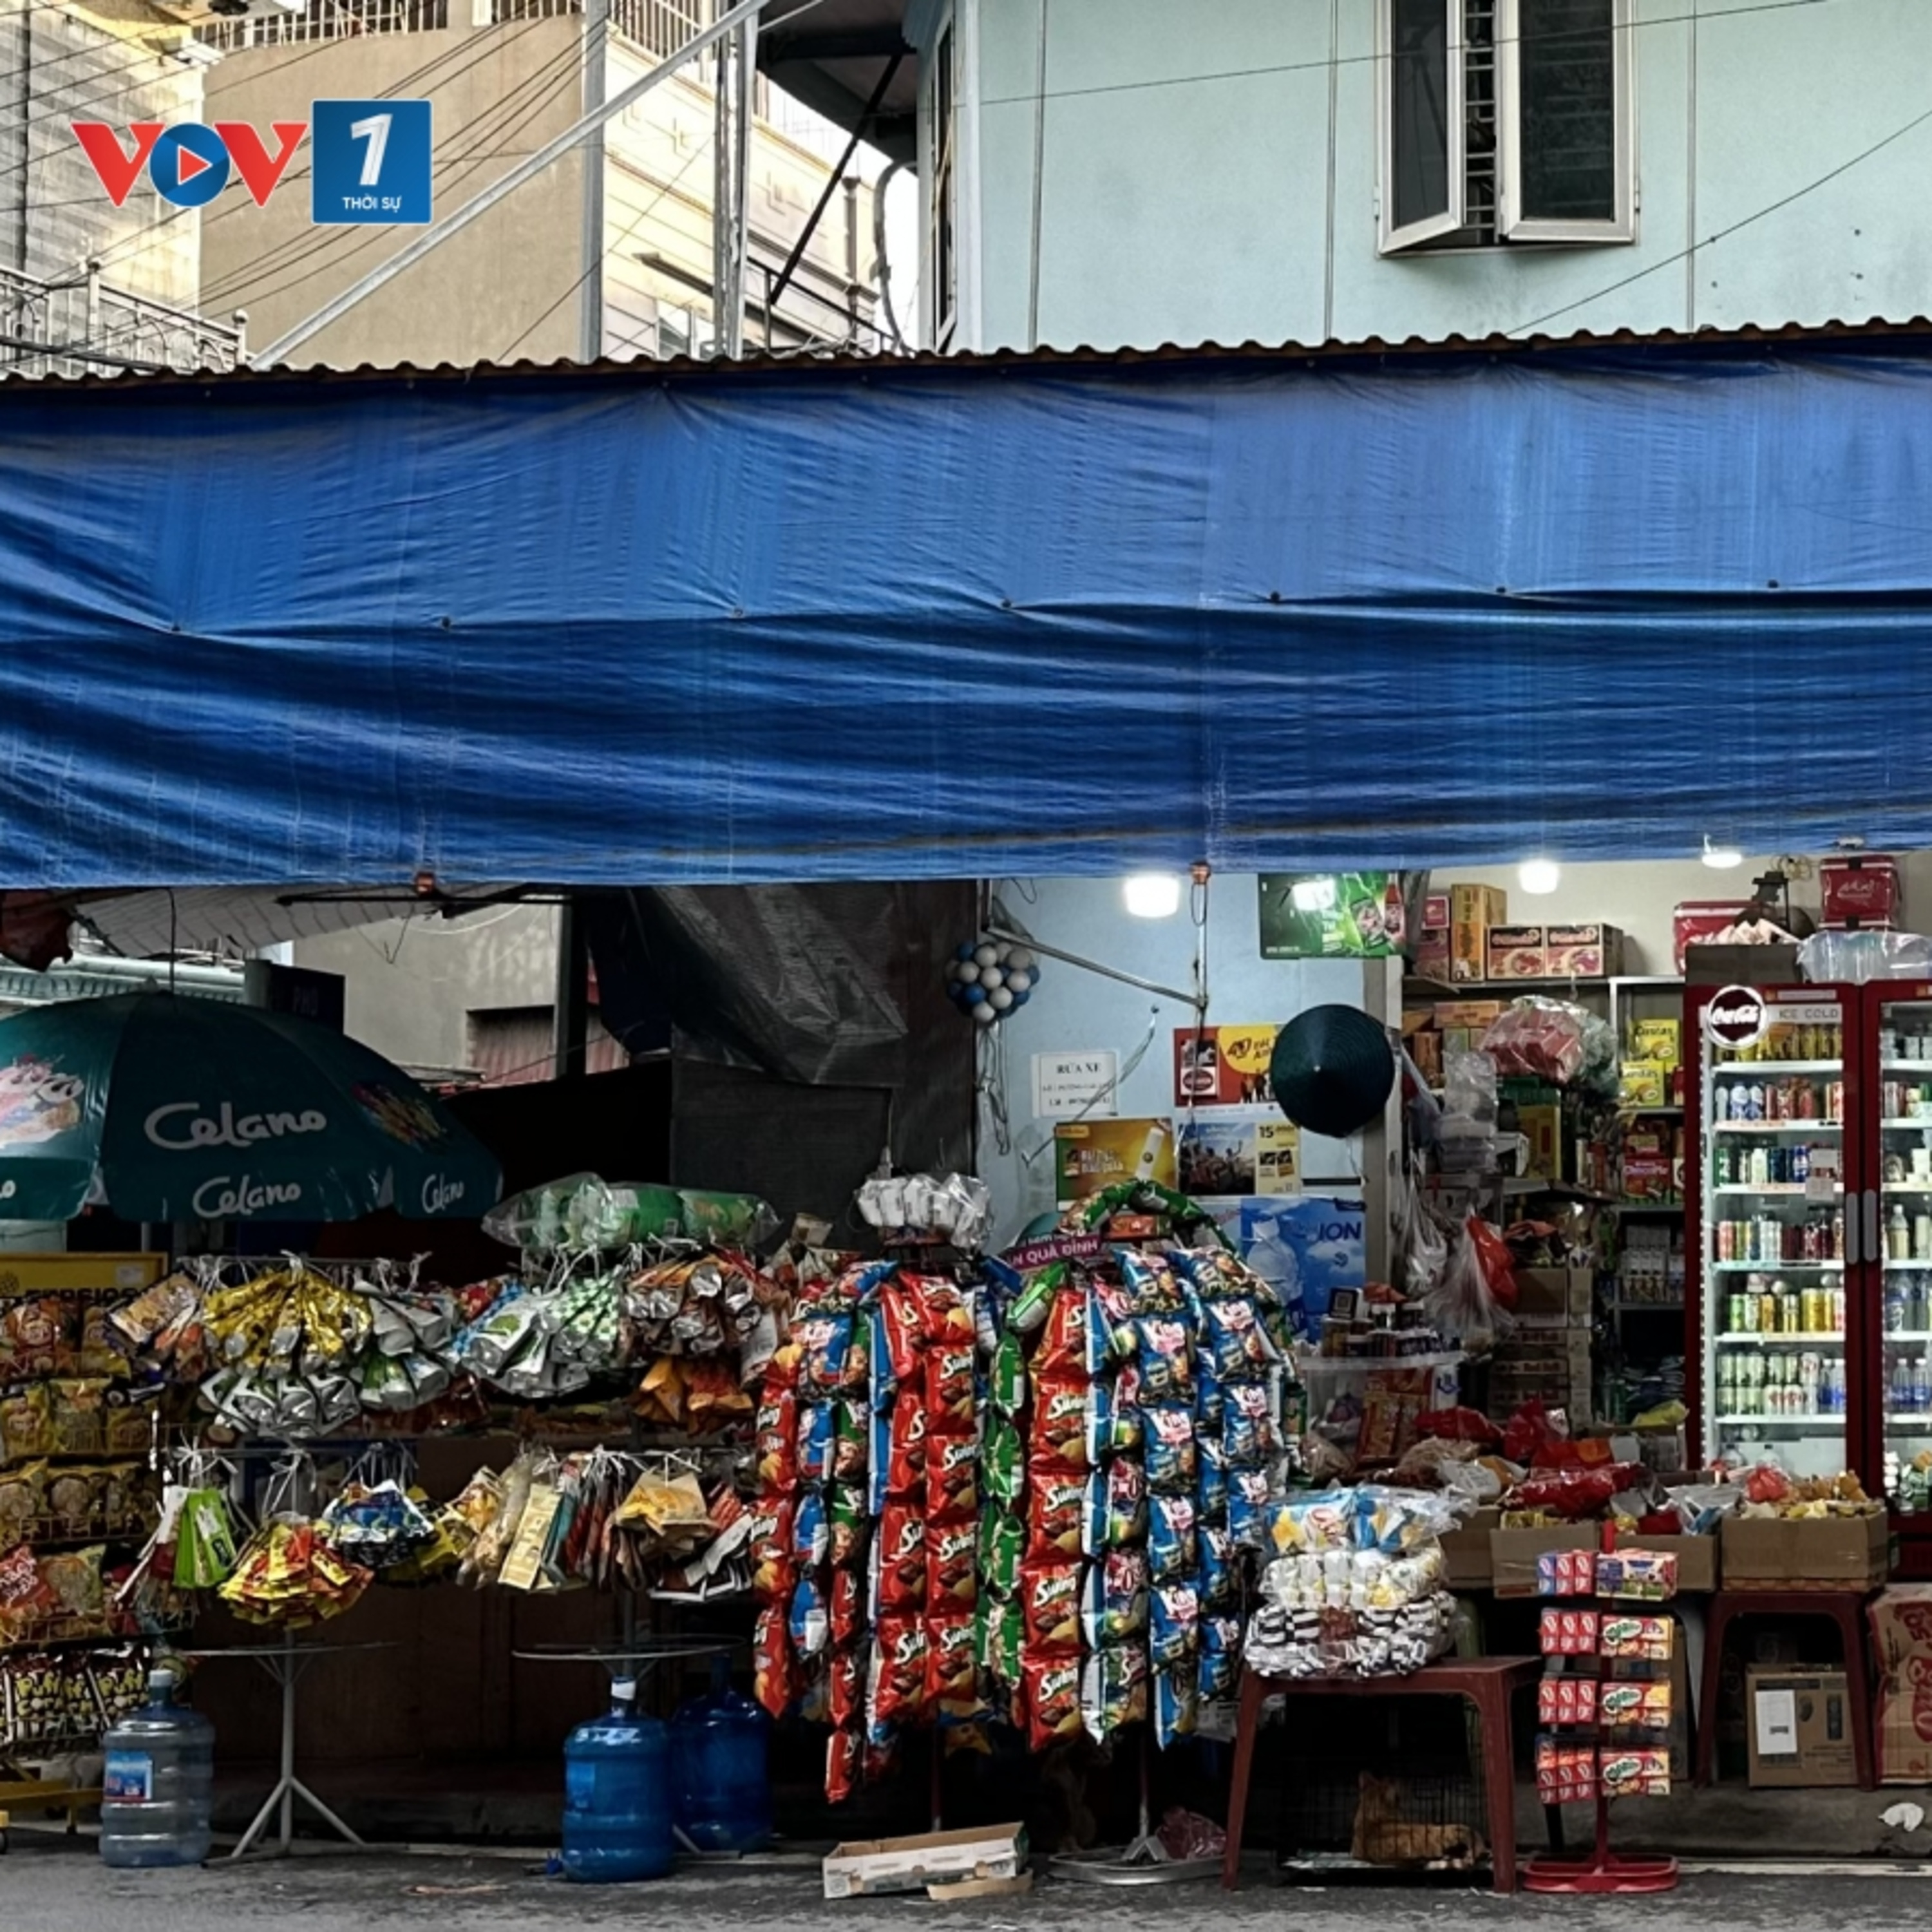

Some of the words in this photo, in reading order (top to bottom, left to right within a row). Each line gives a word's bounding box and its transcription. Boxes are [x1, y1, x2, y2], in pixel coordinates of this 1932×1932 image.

[1779, 1009, 1798, 1019] ICE
[1805, 1008, 1838, 1018] COLD
[145, 1101, 326, 1150] Celano
[1259, 1126, 1274, 1138] 15
[193, 1174, 301, 1219] Celano
[422, 1173, 465, 1214] Celano
